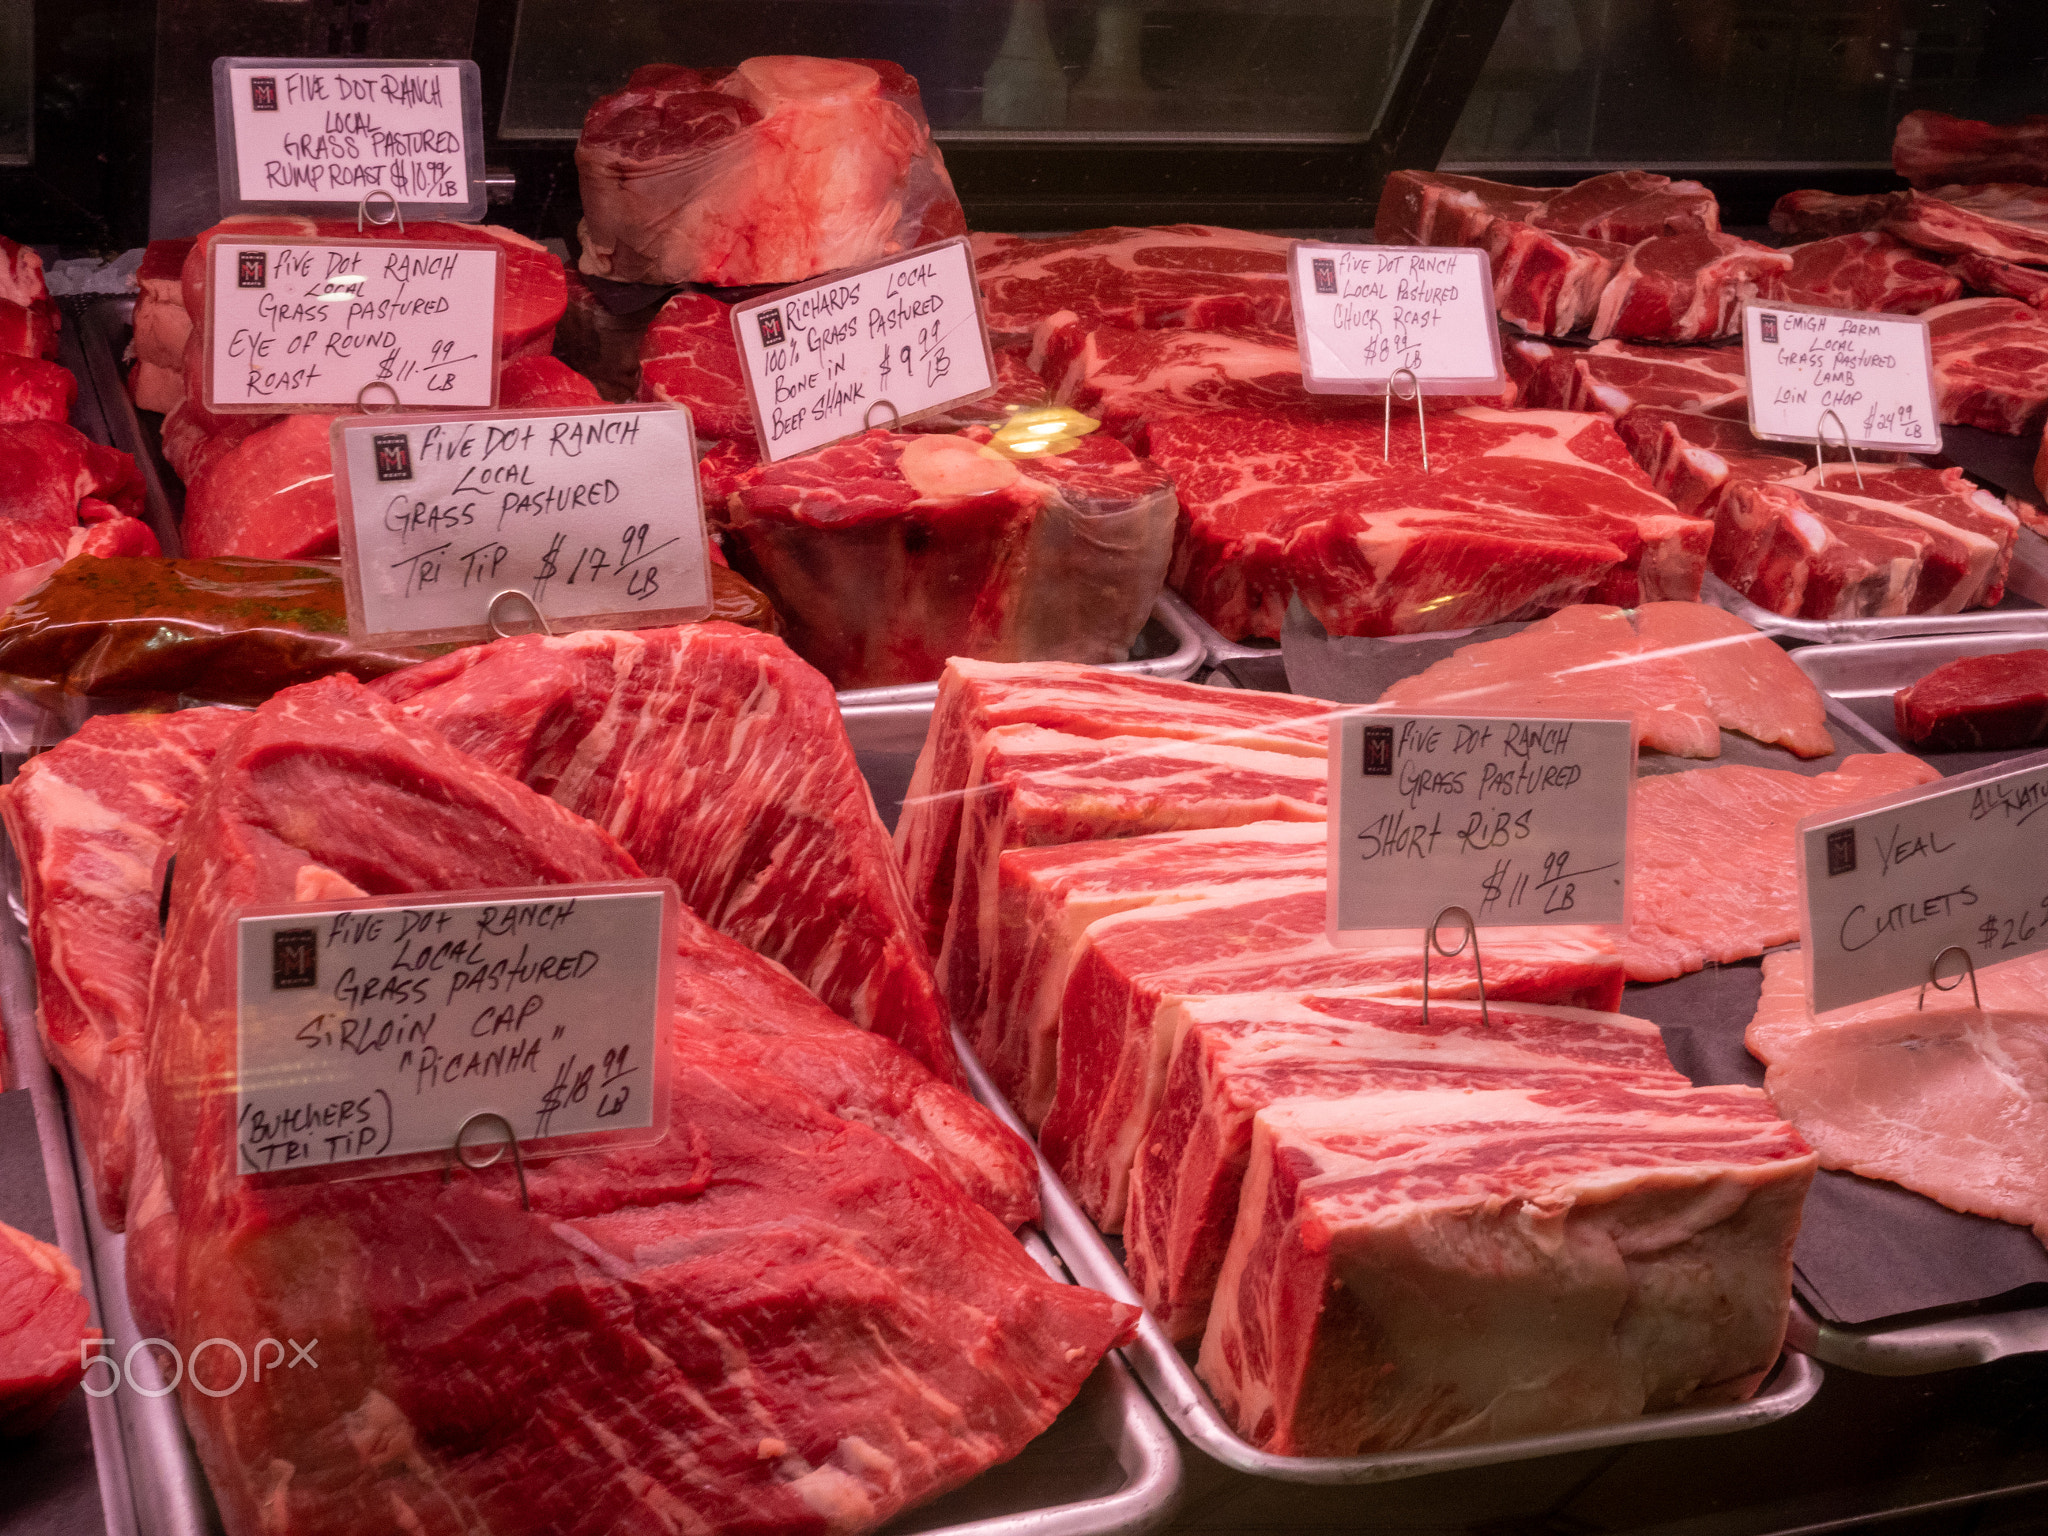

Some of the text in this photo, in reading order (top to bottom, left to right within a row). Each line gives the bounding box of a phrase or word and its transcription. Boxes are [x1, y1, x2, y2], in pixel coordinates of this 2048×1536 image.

[286, 73, 442, 108] FIVE DOT RANCH
[326, 111, 382, 137] LOCAL
[284, 129, 460, 160] GRASS PASTURED
[265, 161, 324, 191] RUMP
[330, 165, 386, 189] ROAST
[385, 253, 459, 282] RANCH
[886, 263, 937, 298] LOCAL
[1410, 255, 1458, 282] RANCH
[1343, 280, 1388, 299] LOCAL
[259, 293, 328, 331] GRASS
[1334, 303, 1382, 334] CHUCK
[228, 329, 397, 369] EYE OF ROUND
[807, 316, 857, 369] GRASS
[1778, 348, 1823, 367] GRASS
[1810, 338, 1853, 352] LOCAL
[1405, 350, 1422, 369] LB
[427, 373, 456, 391] LB
[774, 373, 819, 405] BONE
[1814, 370, 1855, 386] LAMB
[771, 408, 806, 441] BEEF
[811, 382, 865, 420] SHANK
[1821, 390, 1862, 406] CHOP
[550, 416, 639, 457] RANCH
[1905, 425, 1922, 438] LB
[452, 465, 535, 495] LOCAL
[385, 495, 475, 544] GRASS
[627, 567, 659, 600] LB
[1504, 722, 1573, 760] RANCH
[1400, 760, 1467, 809] GRASS
[1970, 784, 2012, 820] ALL
[1875, 823, 1956, 877] VEAL
[1544, 884, 1575, 914] LB
[477, 899, 576, 936] RANCH
[1841, 885, 1978, 951] CUTLETS
[391, 940, 484, 972] LOCAL
[333, 967, 428, 1006] GRASS
[471, 994, 544, 1038] CAP
